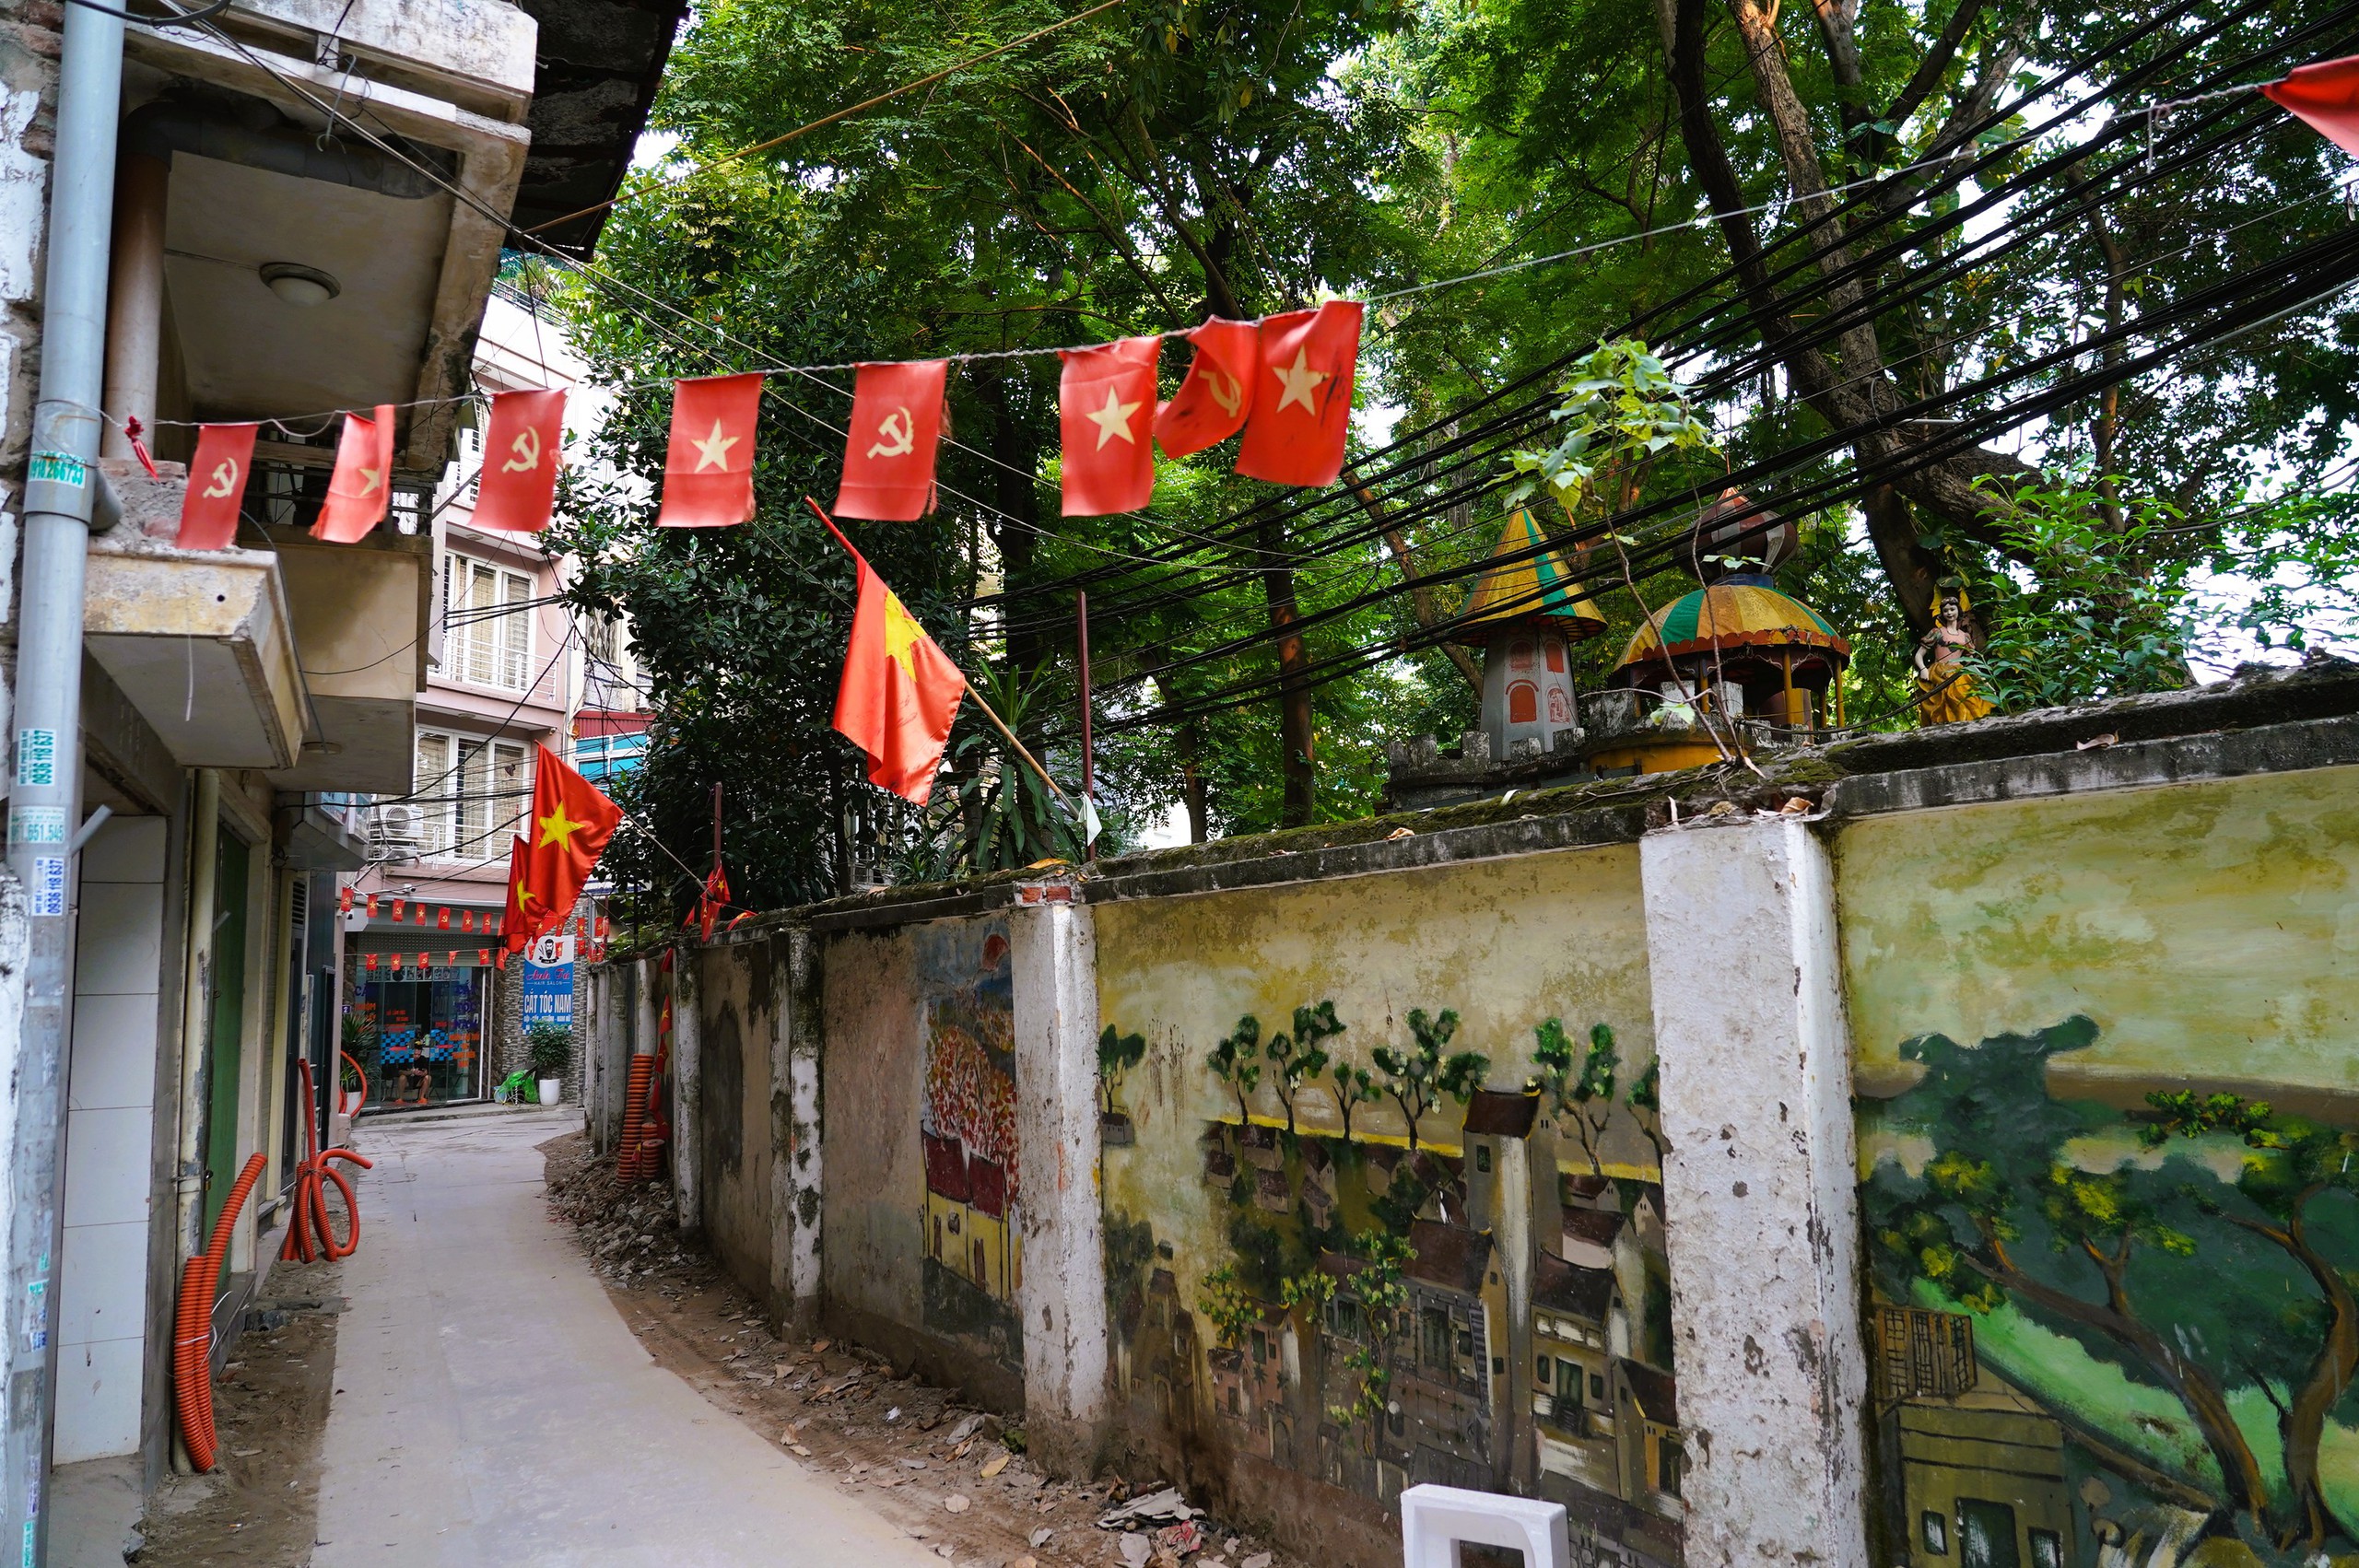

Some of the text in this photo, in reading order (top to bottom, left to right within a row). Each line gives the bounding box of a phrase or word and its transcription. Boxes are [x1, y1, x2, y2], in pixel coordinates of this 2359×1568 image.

[524, 989, 571, 1013] CẮT TÓC NAM
